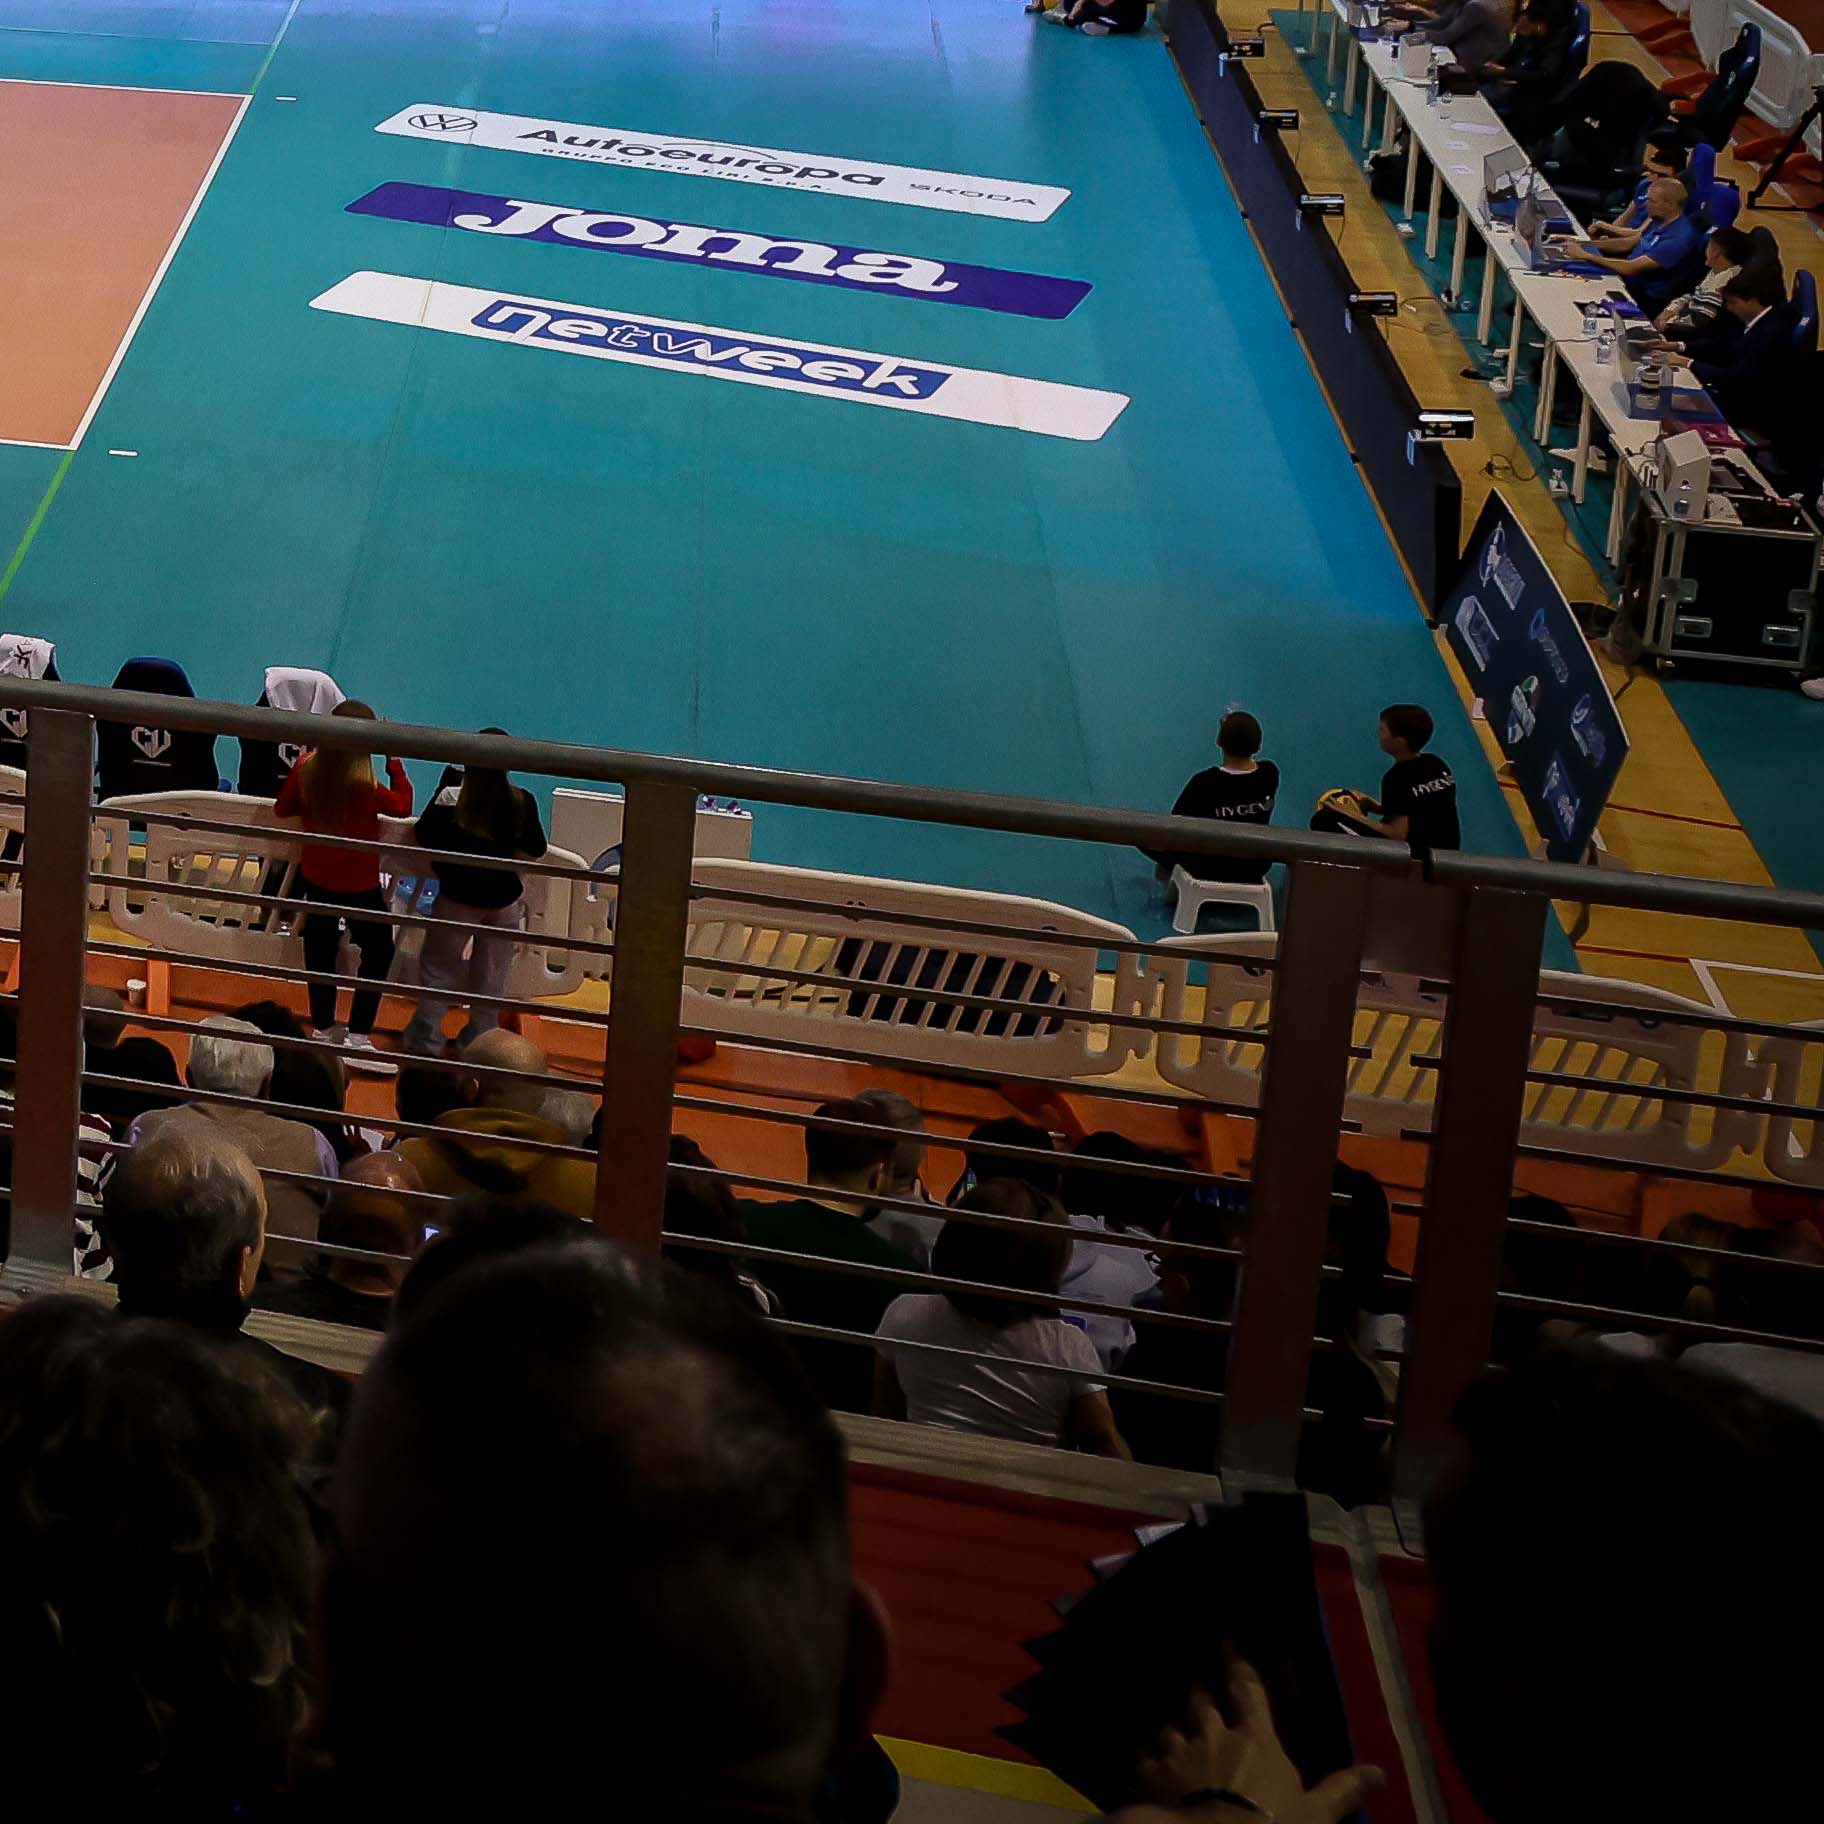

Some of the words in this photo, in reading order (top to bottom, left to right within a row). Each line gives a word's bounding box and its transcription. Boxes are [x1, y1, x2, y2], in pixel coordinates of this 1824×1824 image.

[516, 128, 884, 186] Autoeuropa
[542, 148, 634, 165] GRUPPO
[454, 199, 960, 293] Joma
[487, 304, 919, 396] netweek
